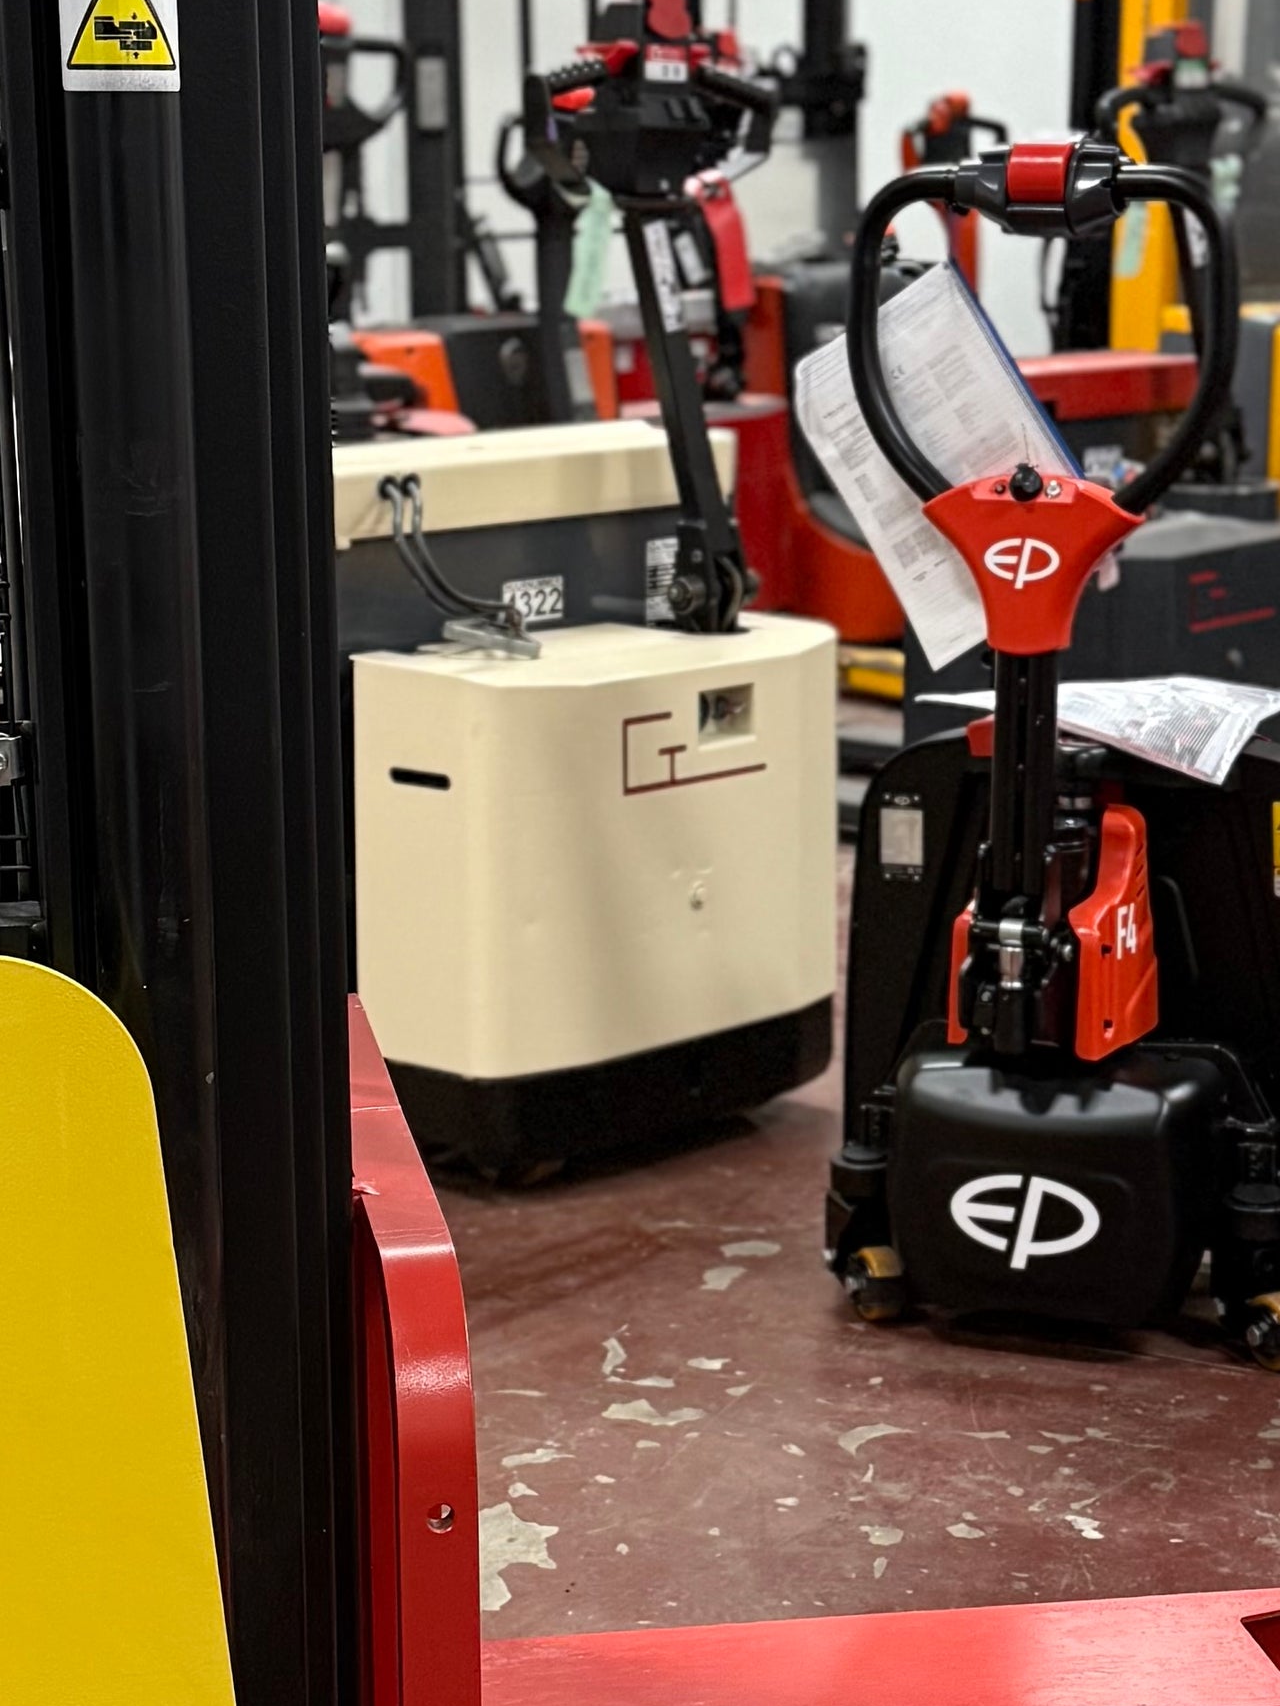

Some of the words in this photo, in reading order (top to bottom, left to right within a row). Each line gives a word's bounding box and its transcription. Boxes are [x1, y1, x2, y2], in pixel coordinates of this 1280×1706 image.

[983, 537, 1061, 590] EP
[1116, 902, 1137, 960] F4
[950, 1174, 1101, 1270] EP
